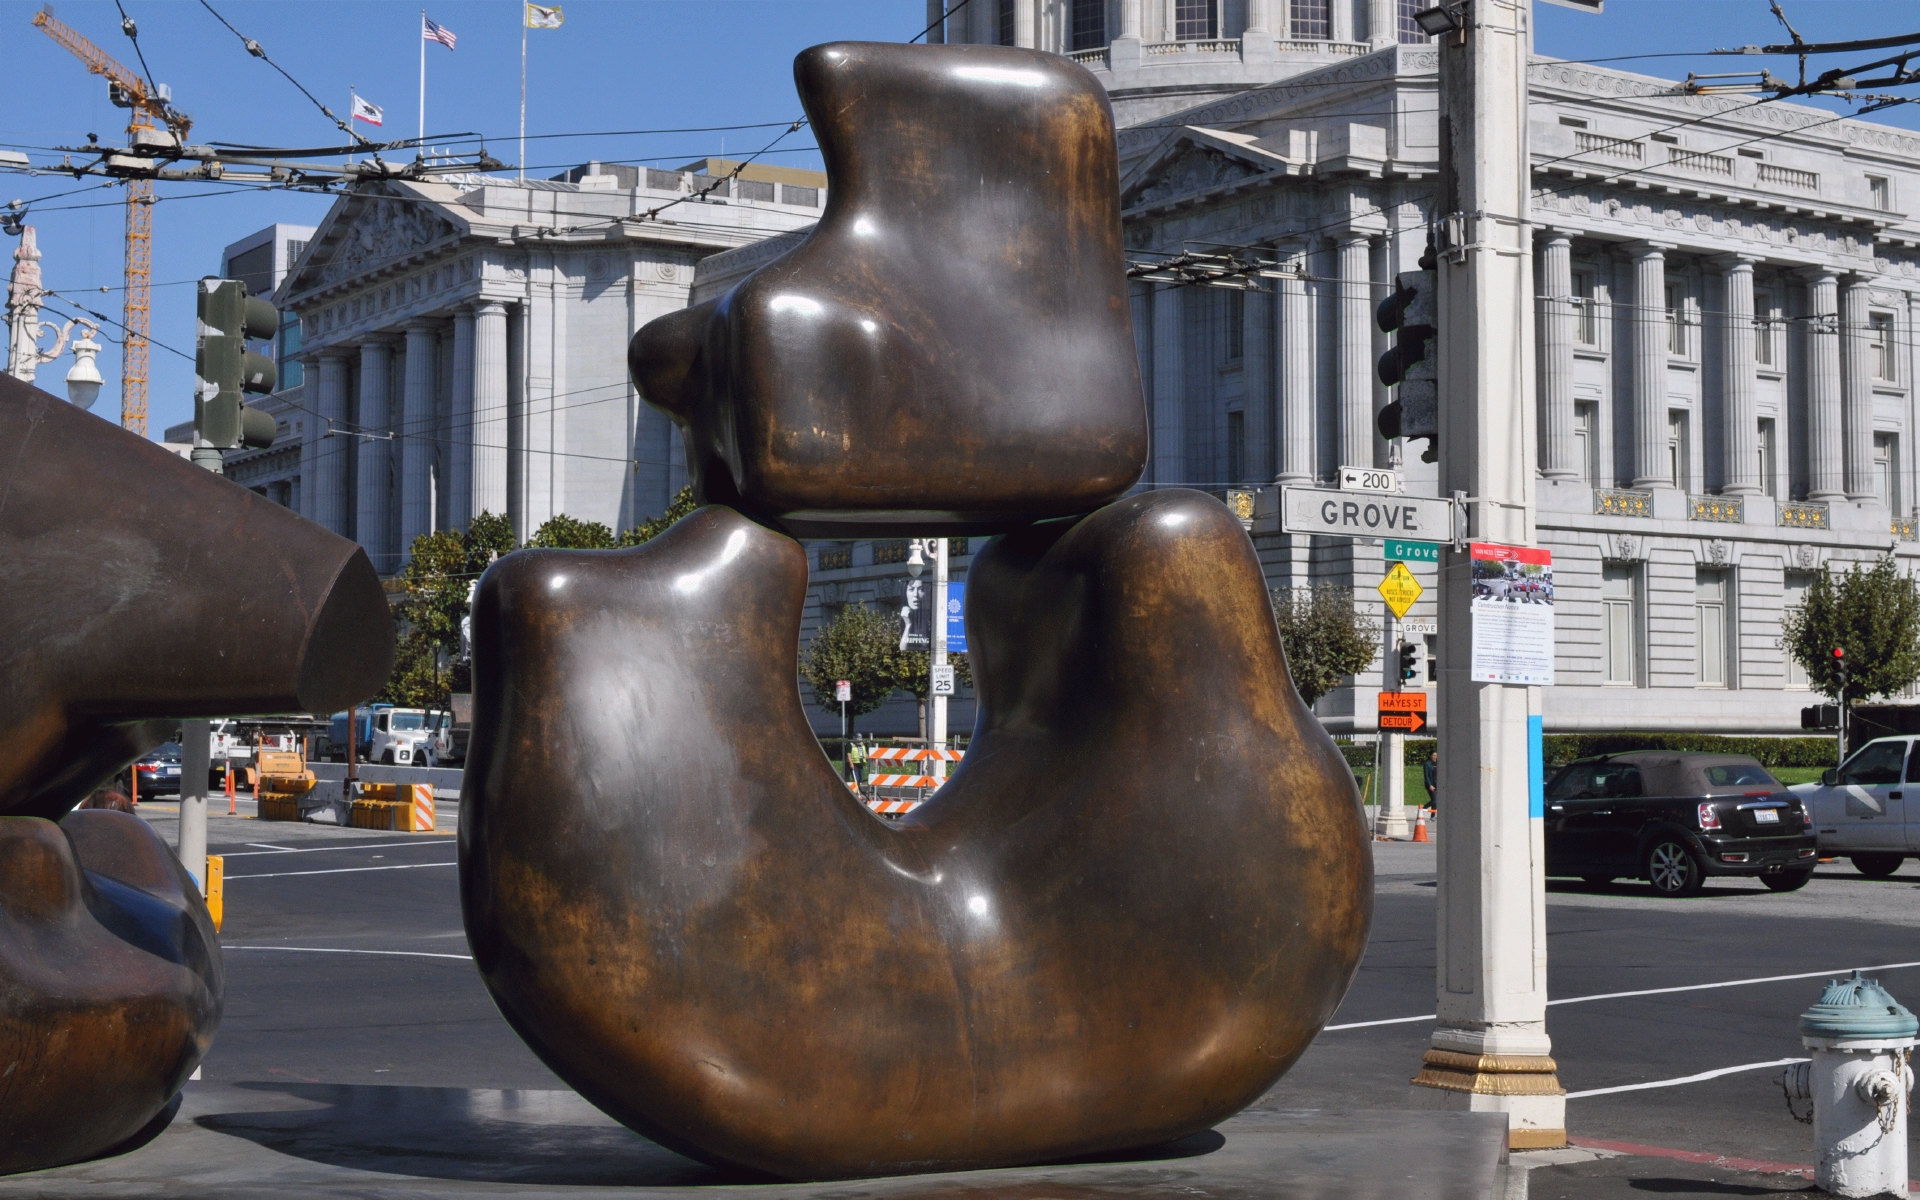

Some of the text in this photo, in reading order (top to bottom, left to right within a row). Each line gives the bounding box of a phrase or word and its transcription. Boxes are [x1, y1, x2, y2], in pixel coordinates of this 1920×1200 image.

[1362, 472, 1390, 489] 200
[1321, 500, 1418, 530] GROVE
[1395, 544, 1438, 558] Grove
[1477, 601, 1505, 610] Construction
[1405, 624, 1436, 632] GROVE
[935, 680, 952, 691] 25
[1382, 699, 1422, 708] HAYES ST
[1383, 717, 1412, 726] DETOUR
